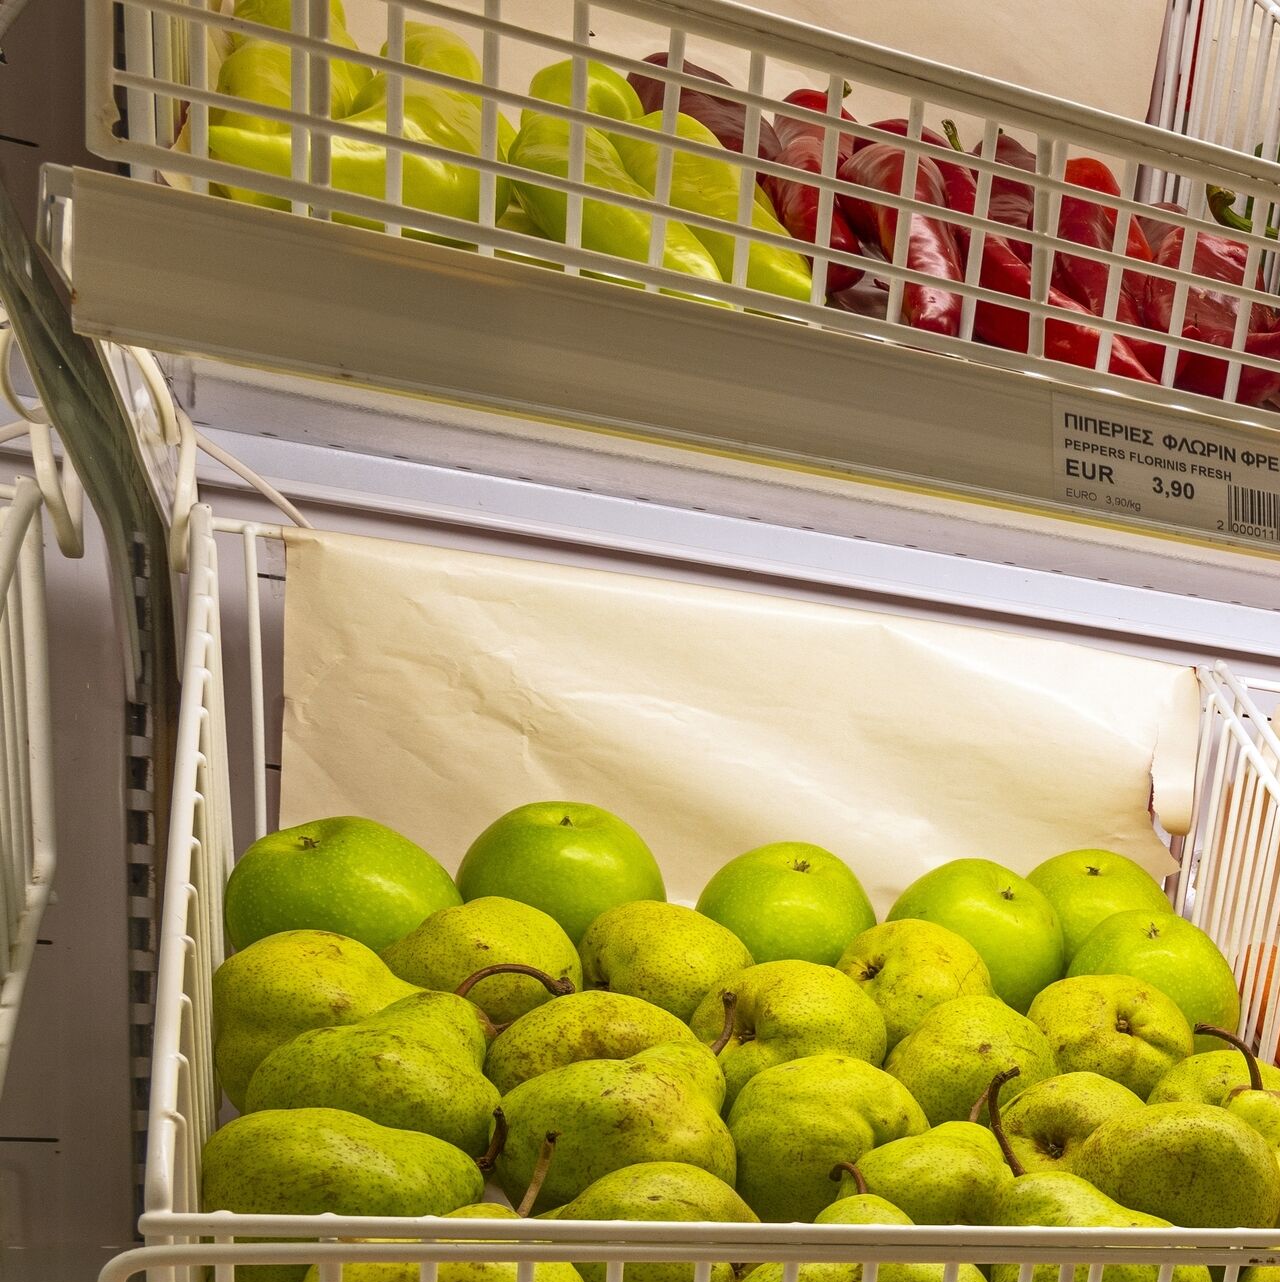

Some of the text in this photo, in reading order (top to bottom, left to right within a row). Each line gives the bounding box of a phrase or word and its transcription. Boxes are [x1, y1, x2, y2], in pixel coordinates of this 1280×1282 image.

[1064, 412, 1154, 446] ΠΙΠΕΡΙΕΣ
[1162, 434, 1237, 463] ΦΛΩΡΙΝ
[1064, 439, 1232, 482] PEPPERS FLORINIS FRESH
[1065, 458, 1195, 500] EUR 3,90
[1065, 487, 1142, 512] EURO 3,90/kg
